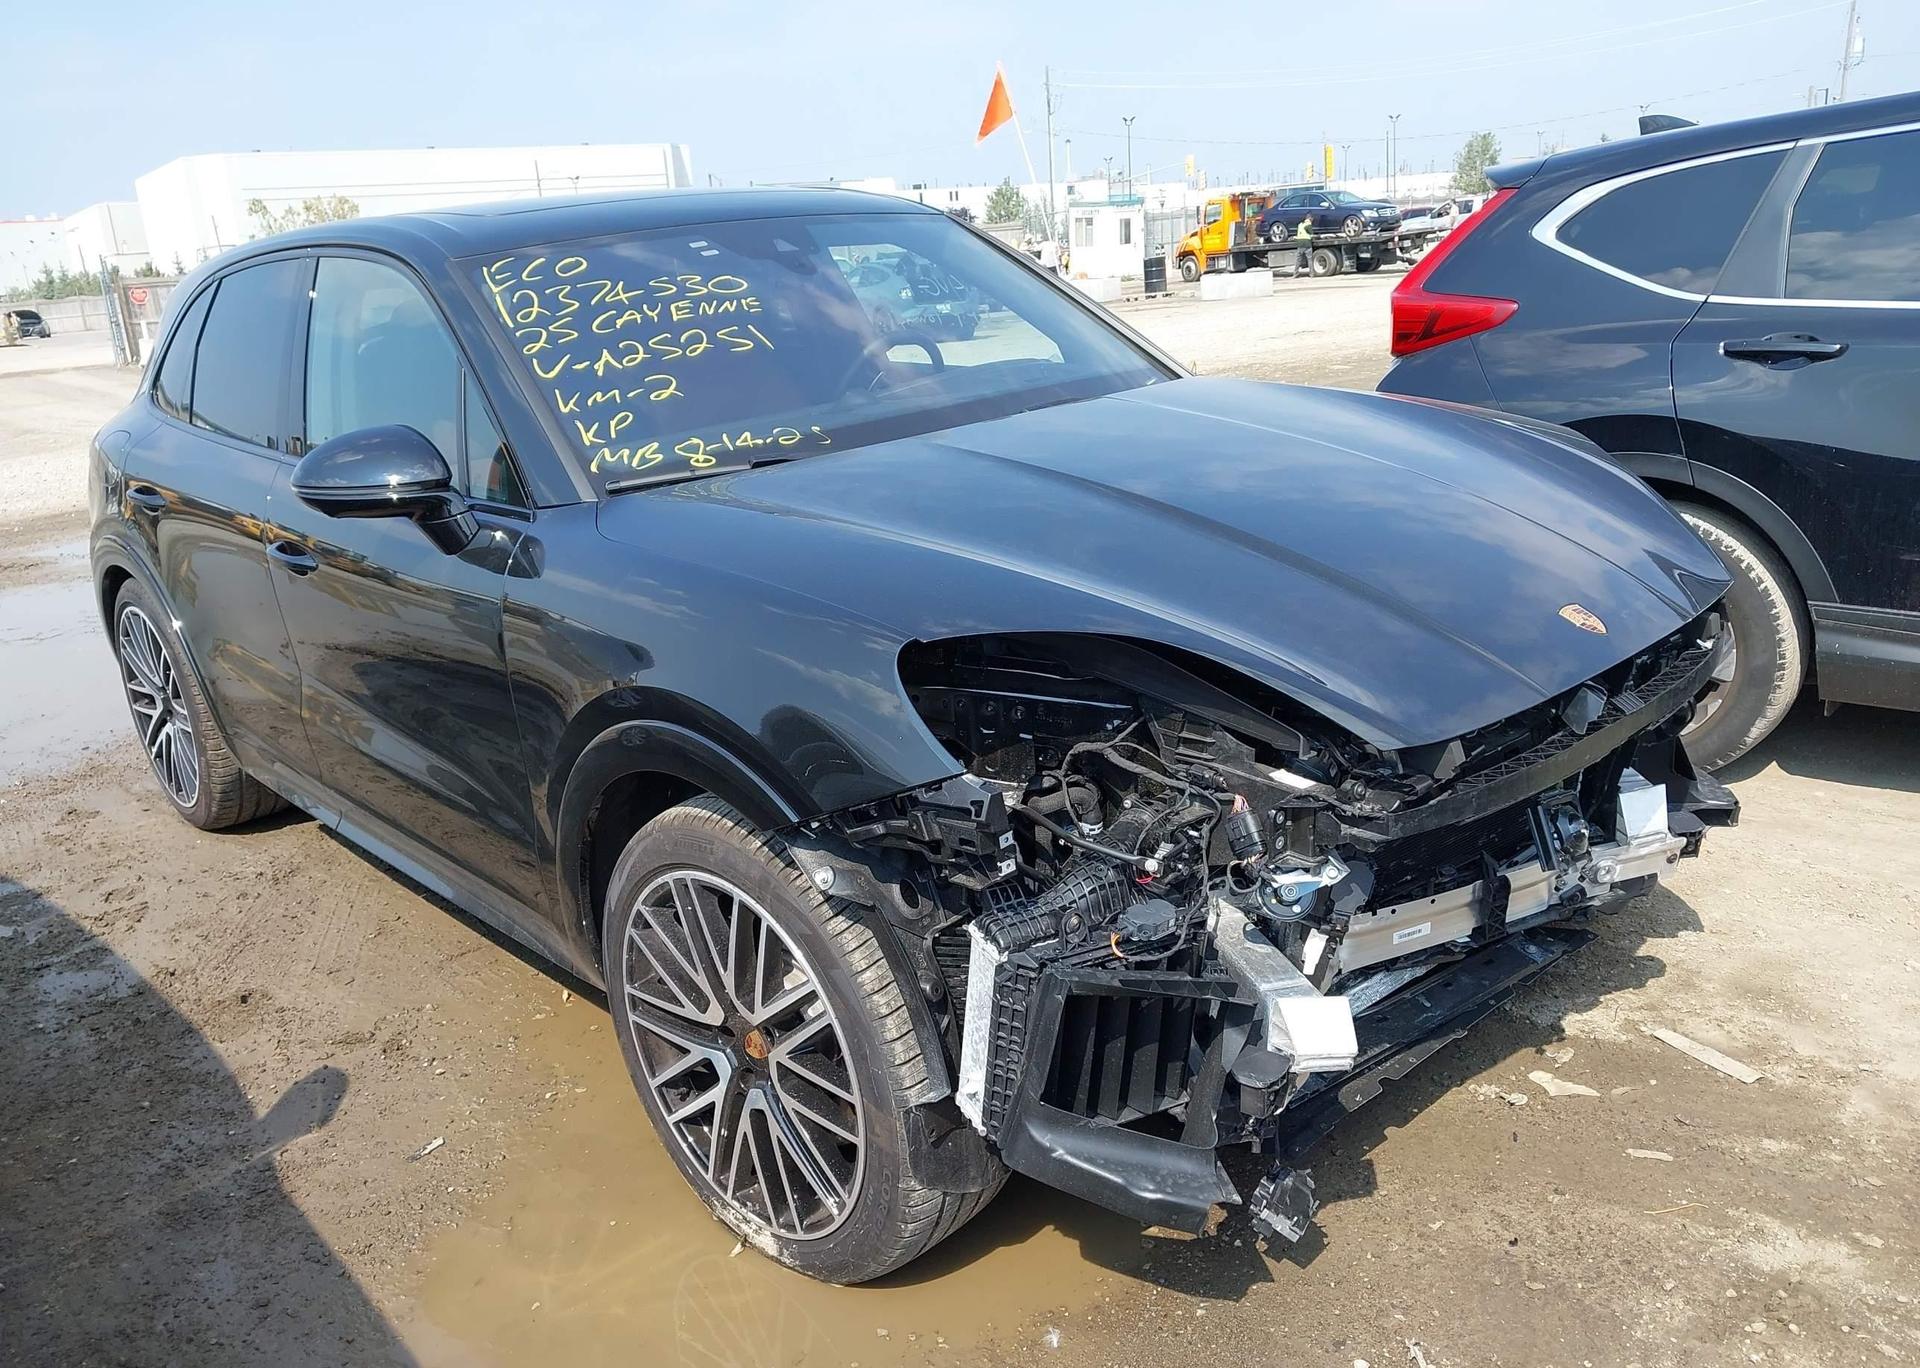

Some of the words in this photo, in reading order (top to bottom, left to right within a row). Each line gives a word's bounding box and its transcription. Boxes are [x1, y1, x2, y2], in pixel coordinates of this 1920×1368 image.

[482, 256, 589, 293] ECO
[515, 316, 580, 354] 25
[591, 296, 764, 333] CAYENNE
[573, 411, 634, 447] KP
[589, 441, 664, 474] MB
